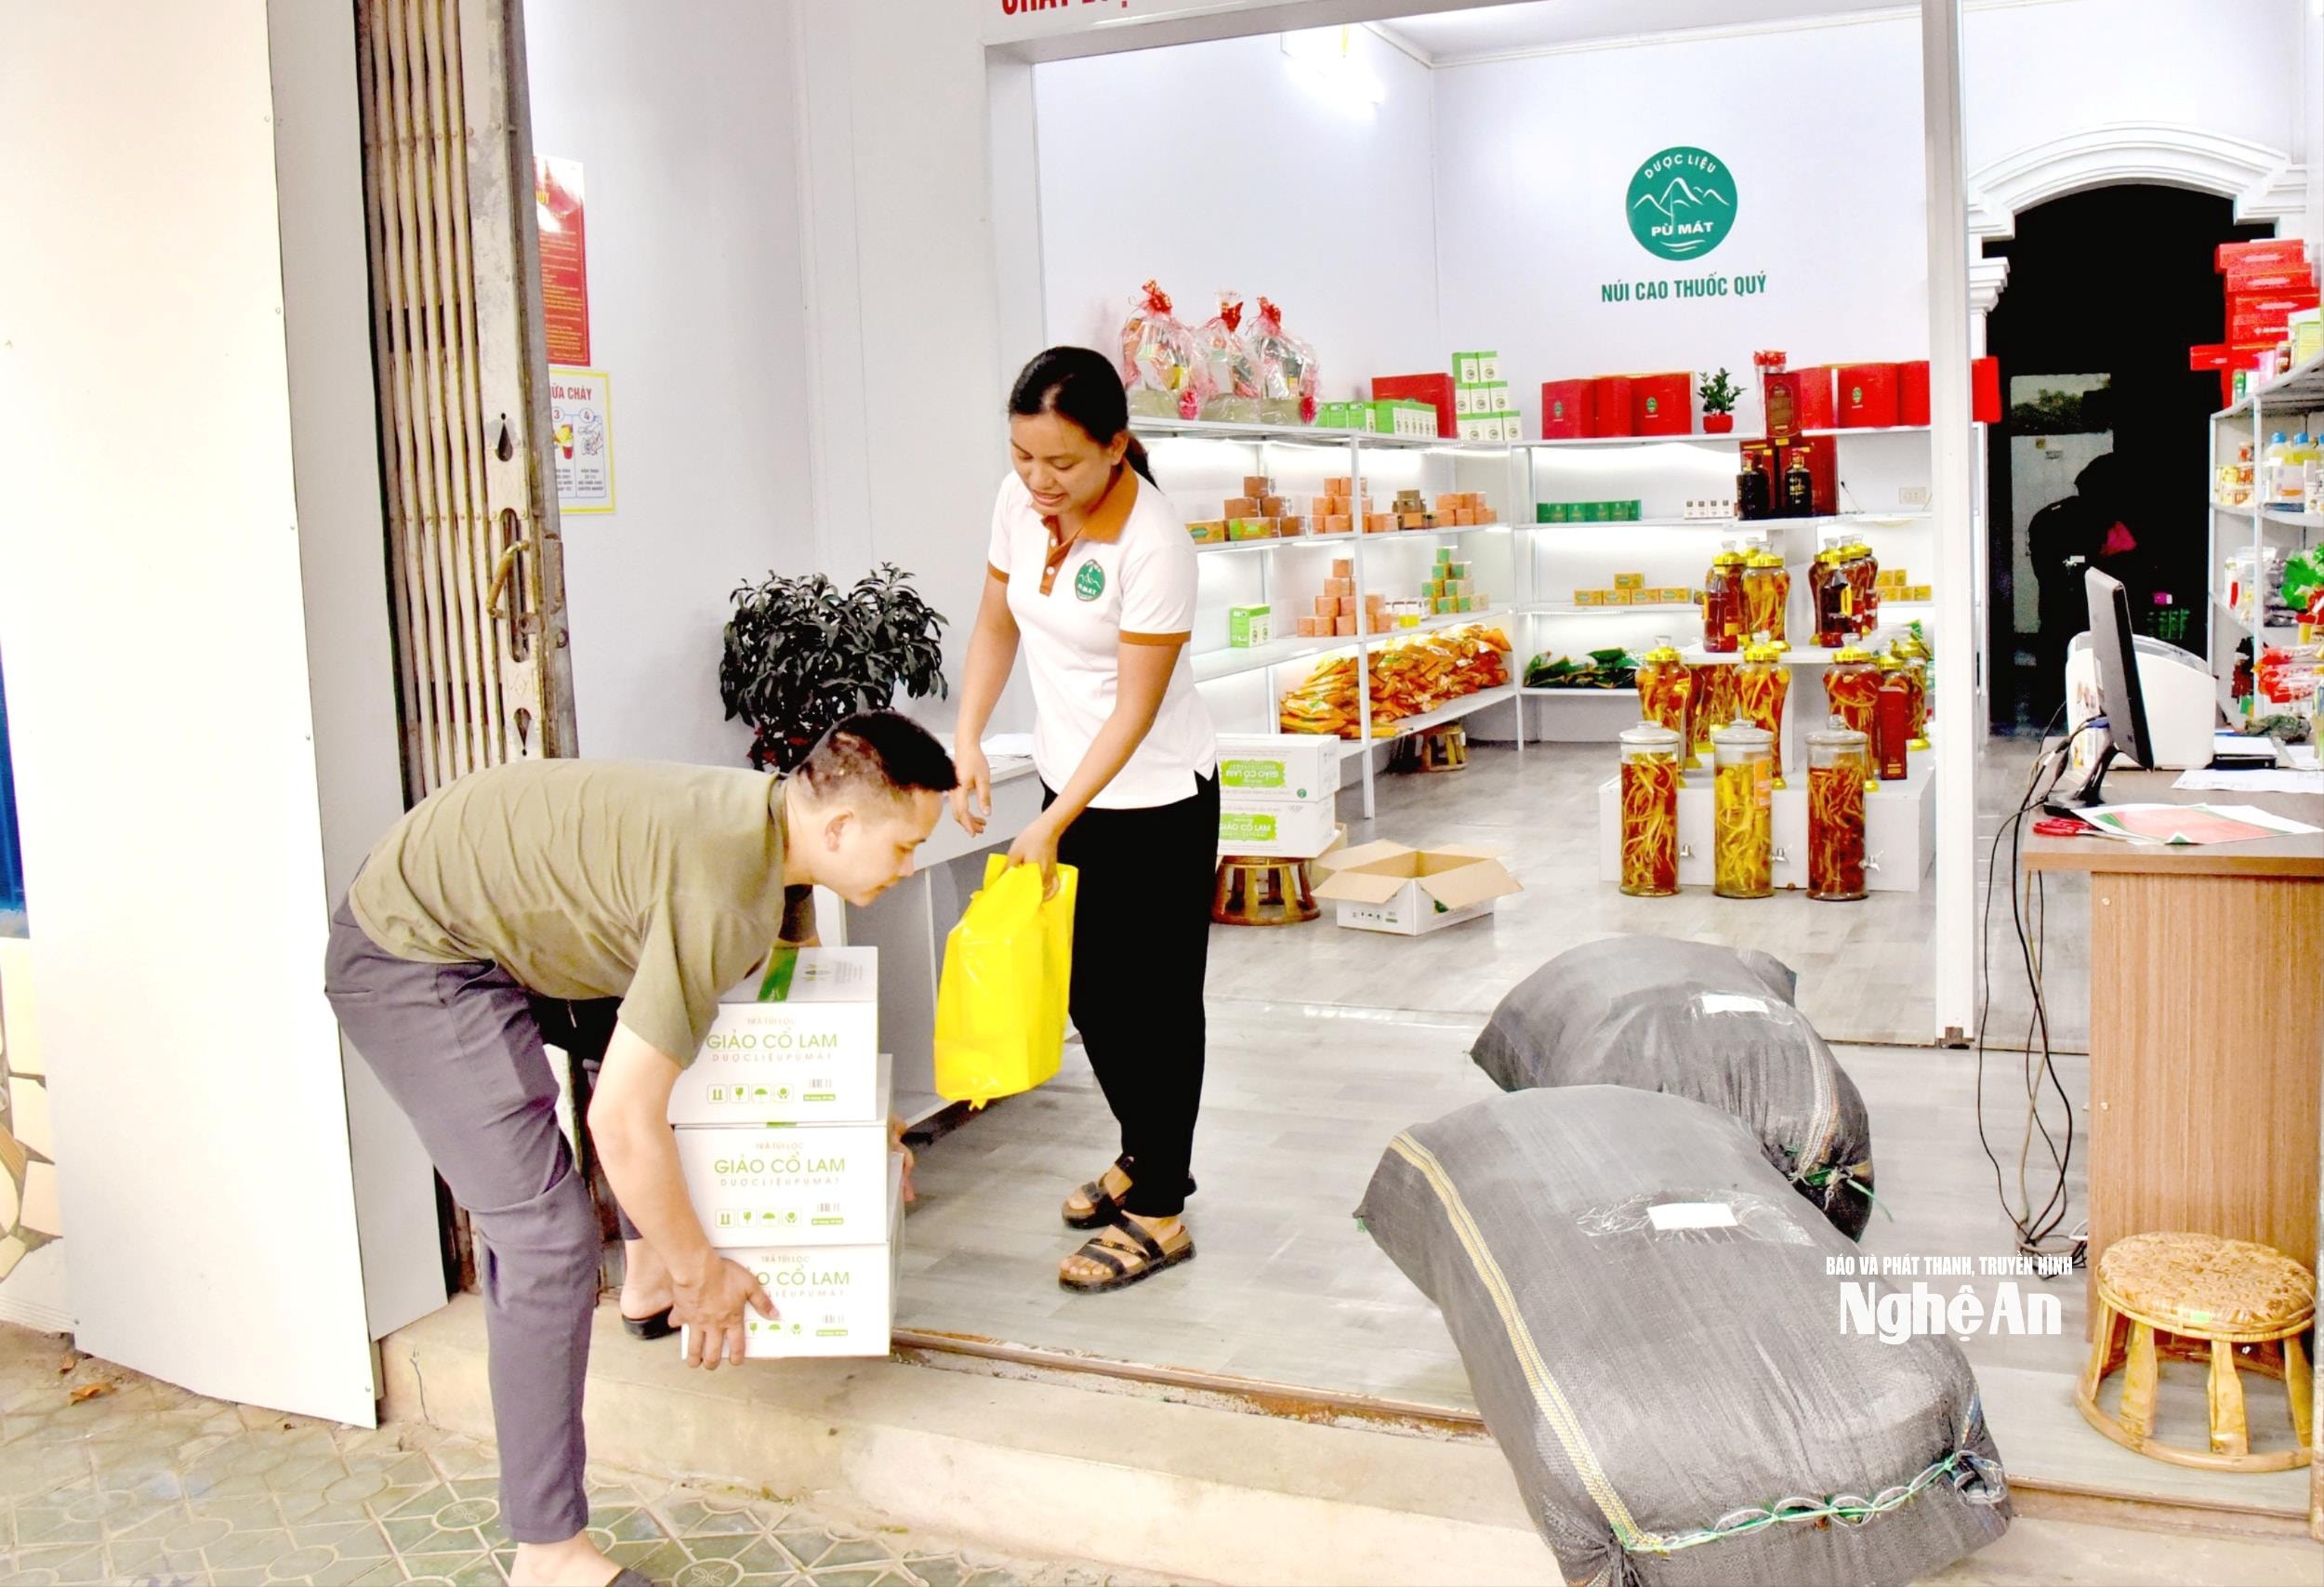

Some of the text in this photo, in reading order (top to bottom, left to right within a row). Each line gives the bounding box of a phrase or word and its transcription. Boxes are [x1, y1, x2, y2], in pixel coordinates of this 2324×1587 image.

[1644, 153, 1717, 179] DƯỢC LIỆU
[1651, 220, 1714, 237] PÙ MÁT
[1601, 271, 1767, 303] NÚI CAO THUỐC QUÝ
[554, 409, 560, 419] 3
[584, 410, 590, 420] 4
[706, 1026, 838, 1050] GIẢO CỔ LAM
[714, 1151, 846, 1174] GIẢO CỔ LAM
[777, 1264, 806, 1286] CỔ
[812, 1271, 850, 1286] LAM
